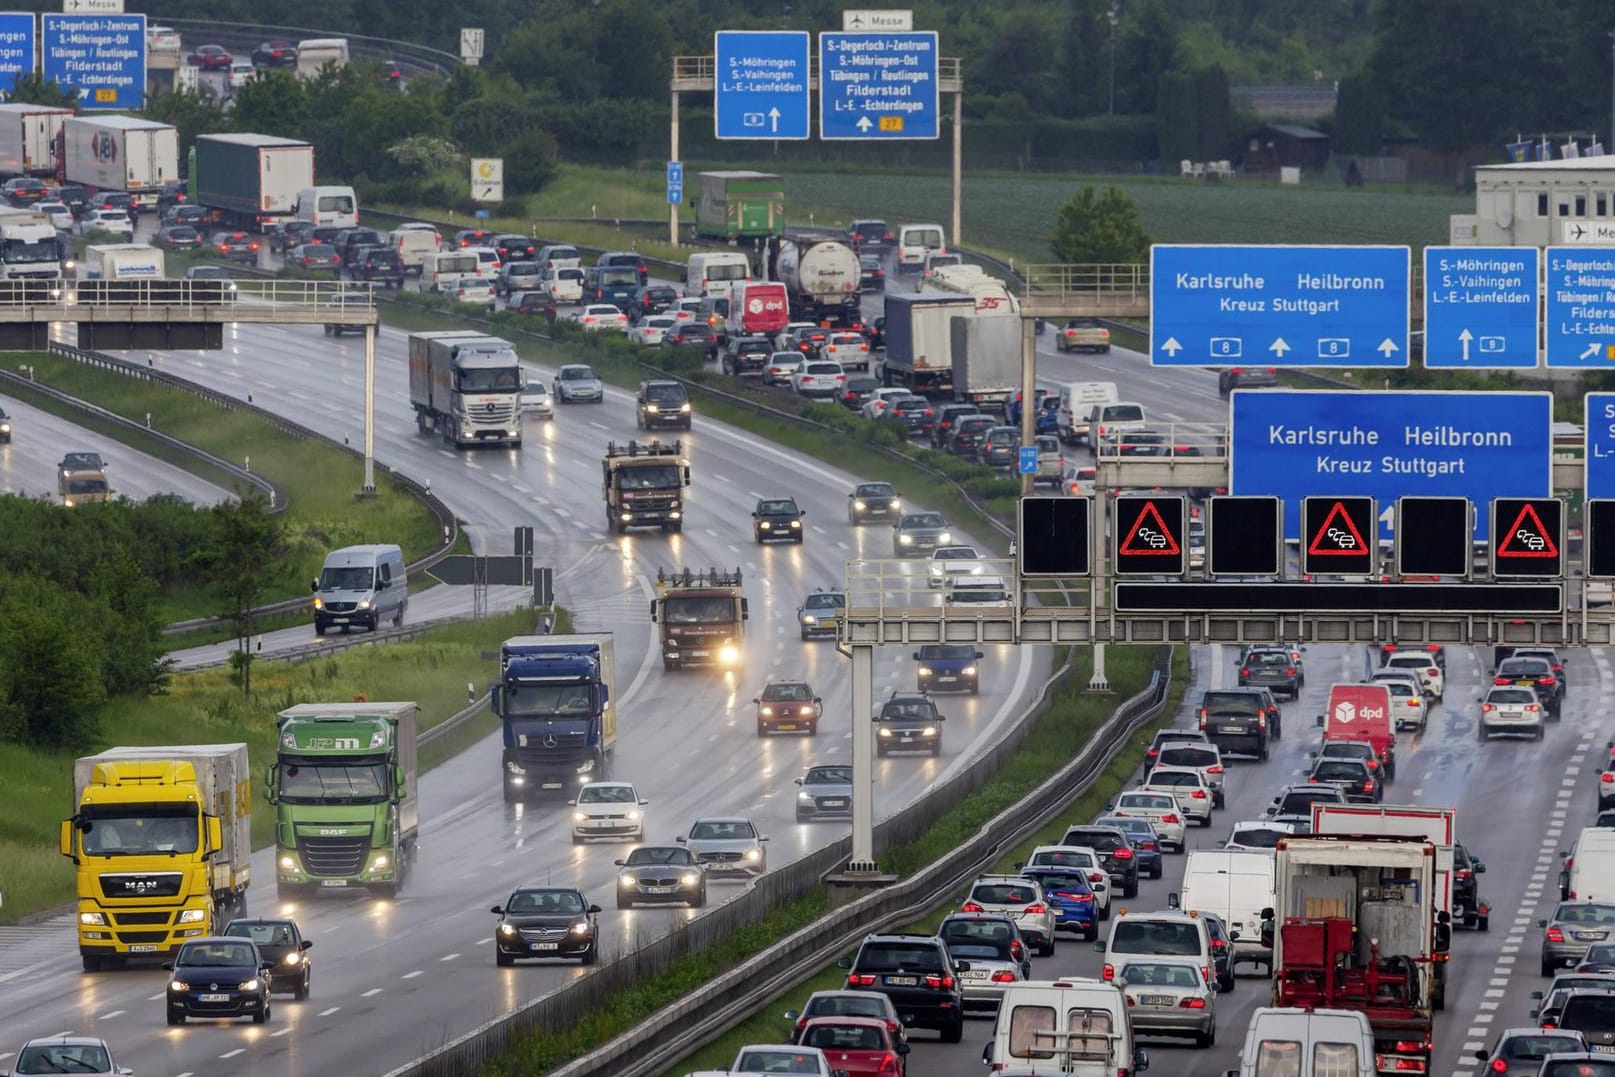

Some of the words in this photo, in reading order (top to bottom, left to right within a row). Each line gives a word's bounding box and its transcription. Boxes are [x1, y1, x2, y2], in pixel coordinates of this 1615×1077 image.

[871, 17, 904, 25] Messe
[51, 47, 86, 59] Tübingen
[96, 48, 138, 59] Reutlingen
[65, 60, 123, 71] Filderstadt
[729, 57, 796, 69] S.-Möhringen
[839, 54, 919, 68] S.-Möhringen-Ost
[731, 70, 794, 82] S.-Vaihingen
[830, 70, 870, 82] Tübingen
[881, 70, 929, 83] Reutlingen
[722, 82, 803, 92] L.-E.-Leinfelden
[846, 85, 912, 96] Filderstadt
[884, 119, 897, 128] 27
[1439, 259, 1524, 274] S.-Möhringen
[1176, 273, 1265, 290] Karlsruhe
[1297, 273, 1385, 290] Heilbronn
[1442, 276, 1521, 290] S.-Vaihingen
[1433, 291, 1530, 303] L.-E.-Leinfelden
[1557, 291, 1599, 305] Tübingen
[764, 297, 783, 312] dpd
[1220, 298, 1265, 312] Kreuz
[1272, 298, 1339, 315] Stuttgart
[1222, 342, 1230, 354] 8
[1330, 342, 1338, 354] 8
[1489, 340, 1496, 349] 8
[1269, 425, 1379, 446] Karlsruhe
[1404, 425, 1512, 447] Heilbronn
[1317, 457, 1372, 474] Kreuz
[1382, 457, 1465, 478] Stuttgart
[1359, 706, 1383, 720] dpd
[125, 881, 157, 889] MAN
